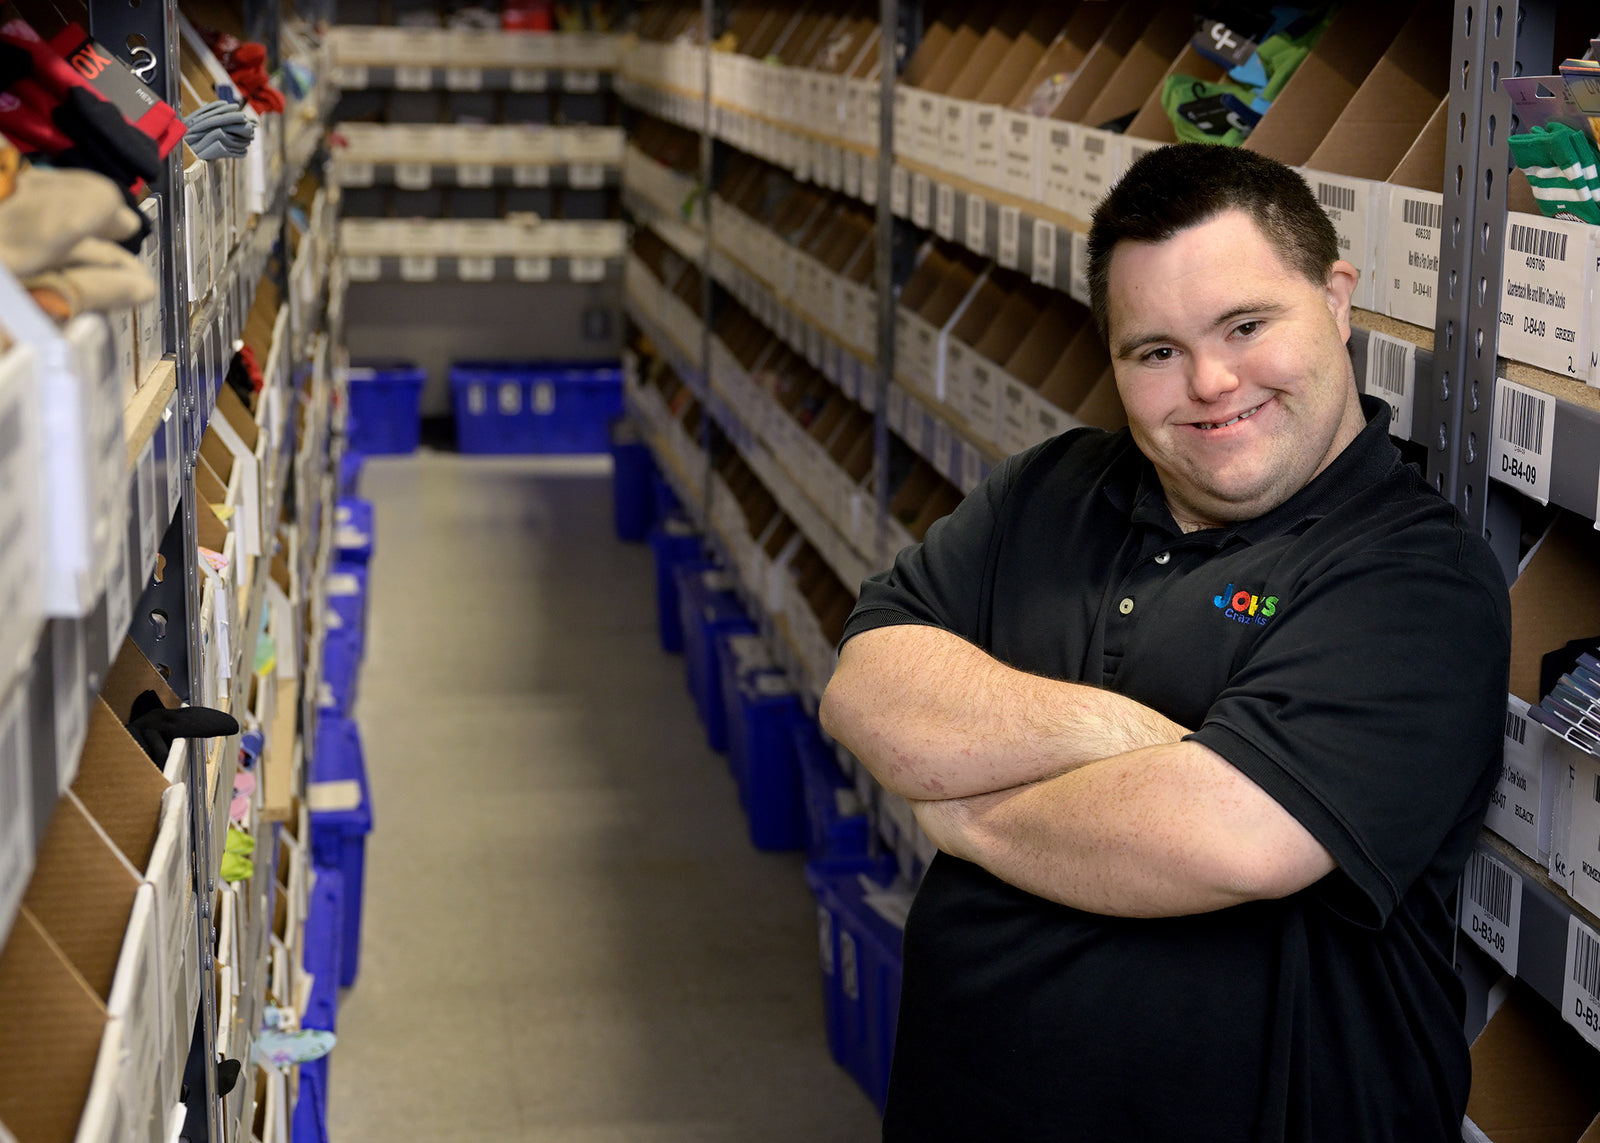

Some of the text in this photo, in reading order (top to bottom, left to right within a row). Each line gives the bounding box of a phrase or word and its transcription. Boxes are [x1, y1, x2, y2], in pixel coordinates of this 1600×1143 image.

[1525, 256, 1546, 272] 409706
[1546, 288, 1555, 306] Crew
[1555, 290, 1566, 309] Socks
[1523, 316, 1546, 337] D-B4-09
[1555, 327, 1576, 343] GREEN
[1567, 355, 1576, 374] 2
[1502, 454, 1536, 485] D-B4-09
[1213, 583, 1280, 617] JOH'S
[1224, 608, 1252, 625] craz
[1491, 789, 1535, 826] B3-07 BLACK
[1472, 914, 1505, 953] D-B3-09
